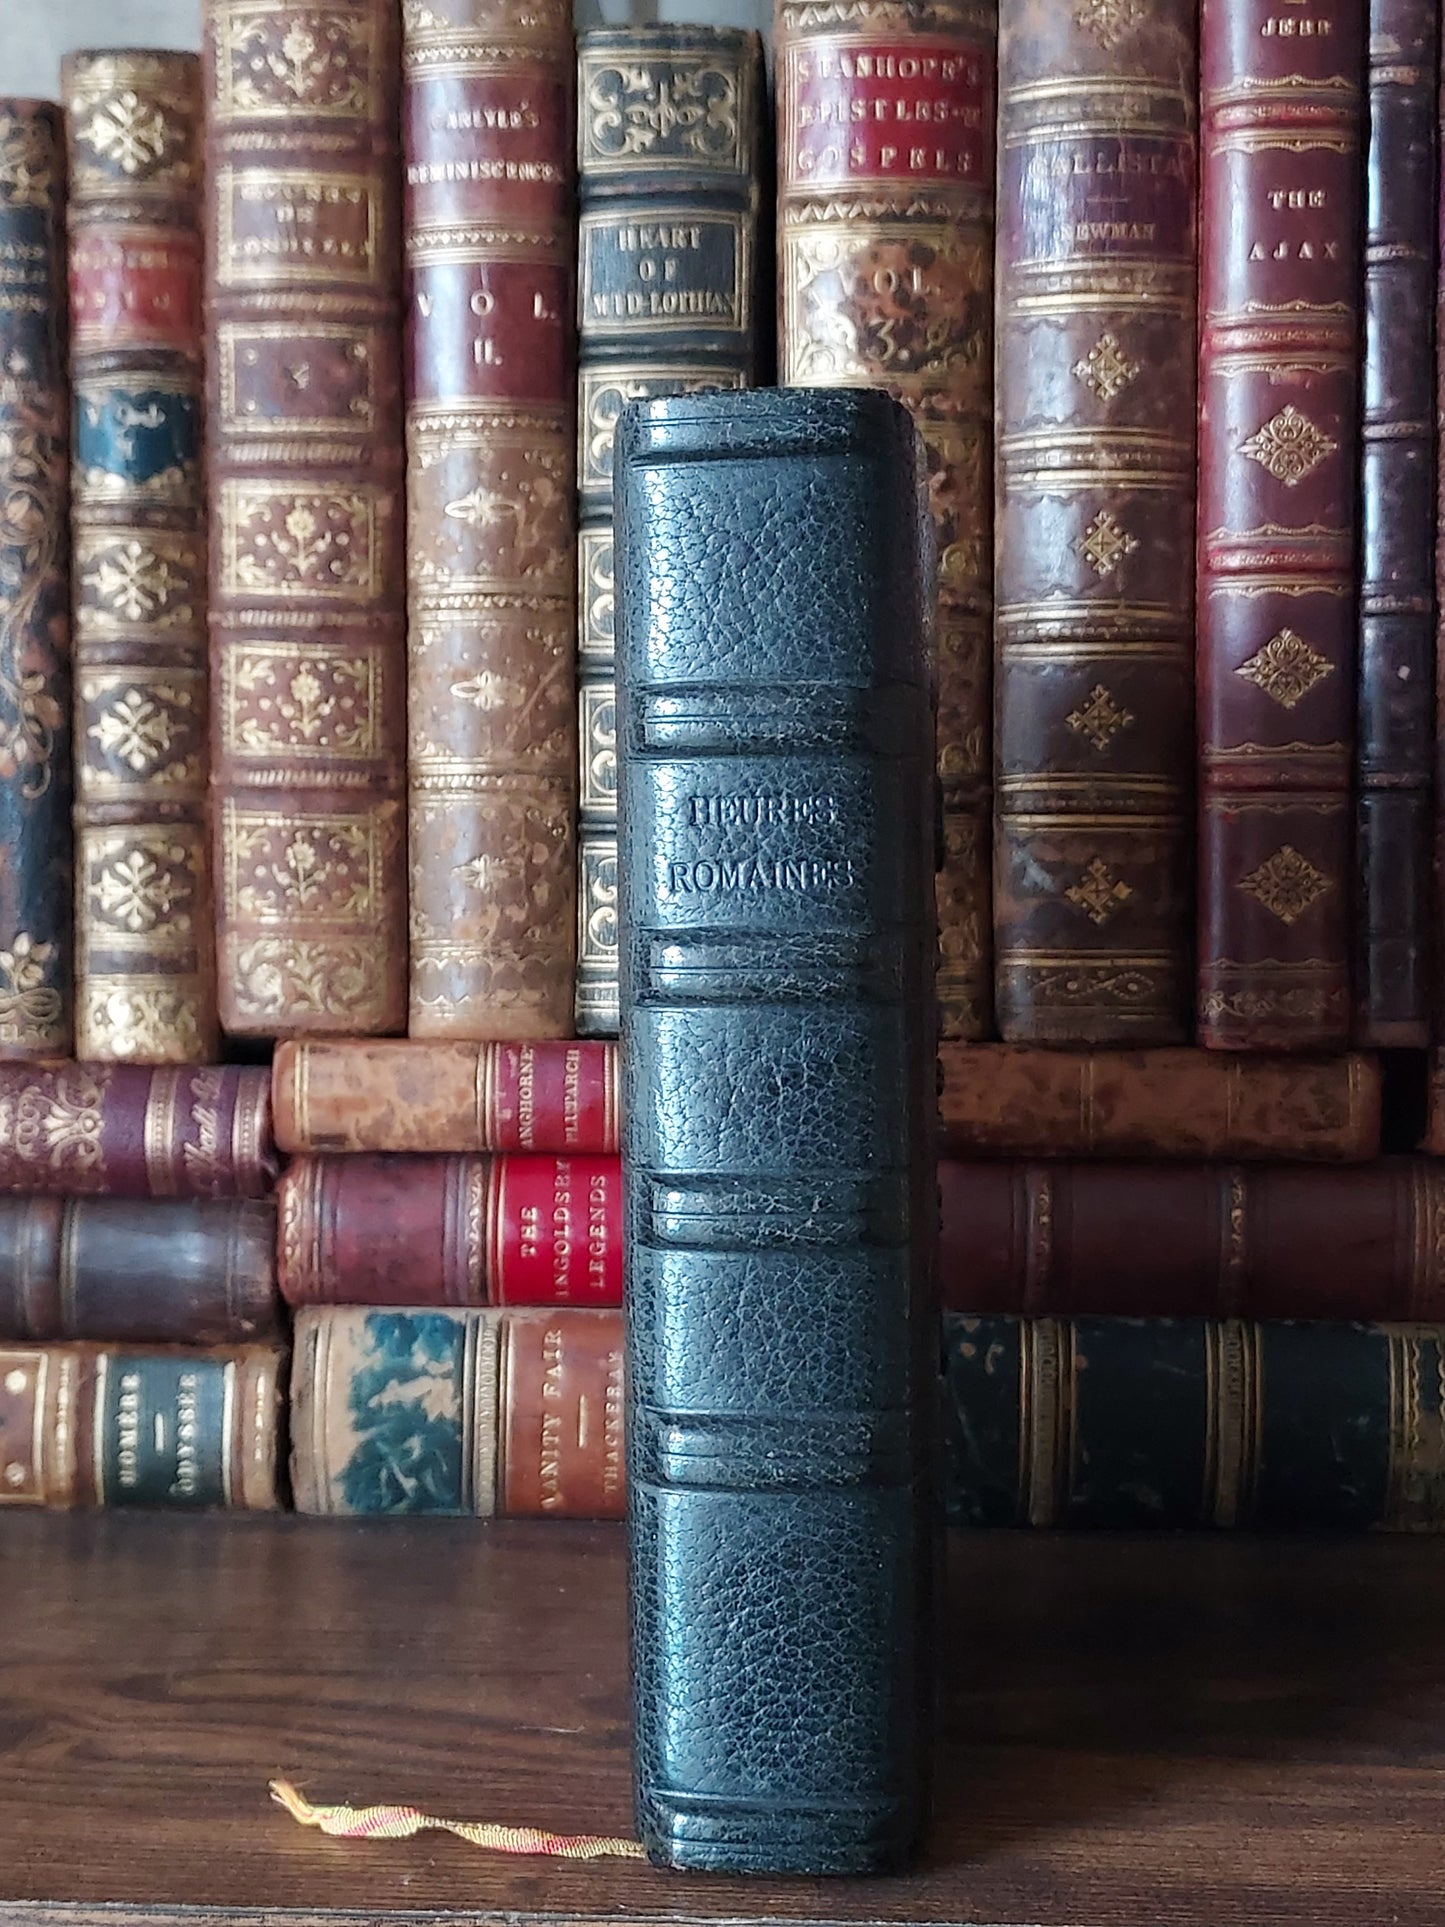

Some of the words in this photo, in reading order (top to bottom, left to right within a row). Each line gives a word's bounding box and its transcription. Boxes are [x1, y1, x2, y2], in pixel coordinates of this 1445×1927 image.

[798, 55, 980, 85] STANHOPE'S
[431, 99, 539, 128] CARLYLE'S
[798, 98, 949, 127] EPISTLES
[798, 145, 971, 173] GOSPELS
[1267, 189, 1326, 209] THE
[619, 226, 701, 251] HEART
[1057, 221, 1155, 241] NEWMAN
[1247, 241, 1339, 260] AJAX
[639, 257, 676, 281] OF
[687, 795, 838, 827] HEURES
[668, 858, 854, 895] ROMAINES
[564, 1048, 580, 1144] PLUTARCH
[520, 1206, 538, 1258] THE
[553, 1158, 572, 1297] INGOLDSBY
[589, 1175, 606, 1288] LEGENDS
[542, 1329, 562, 1398] FAIR
[605, 1350, 624, 1494] THACKERAY
[540, 1413, 562, 1509] VANITY
